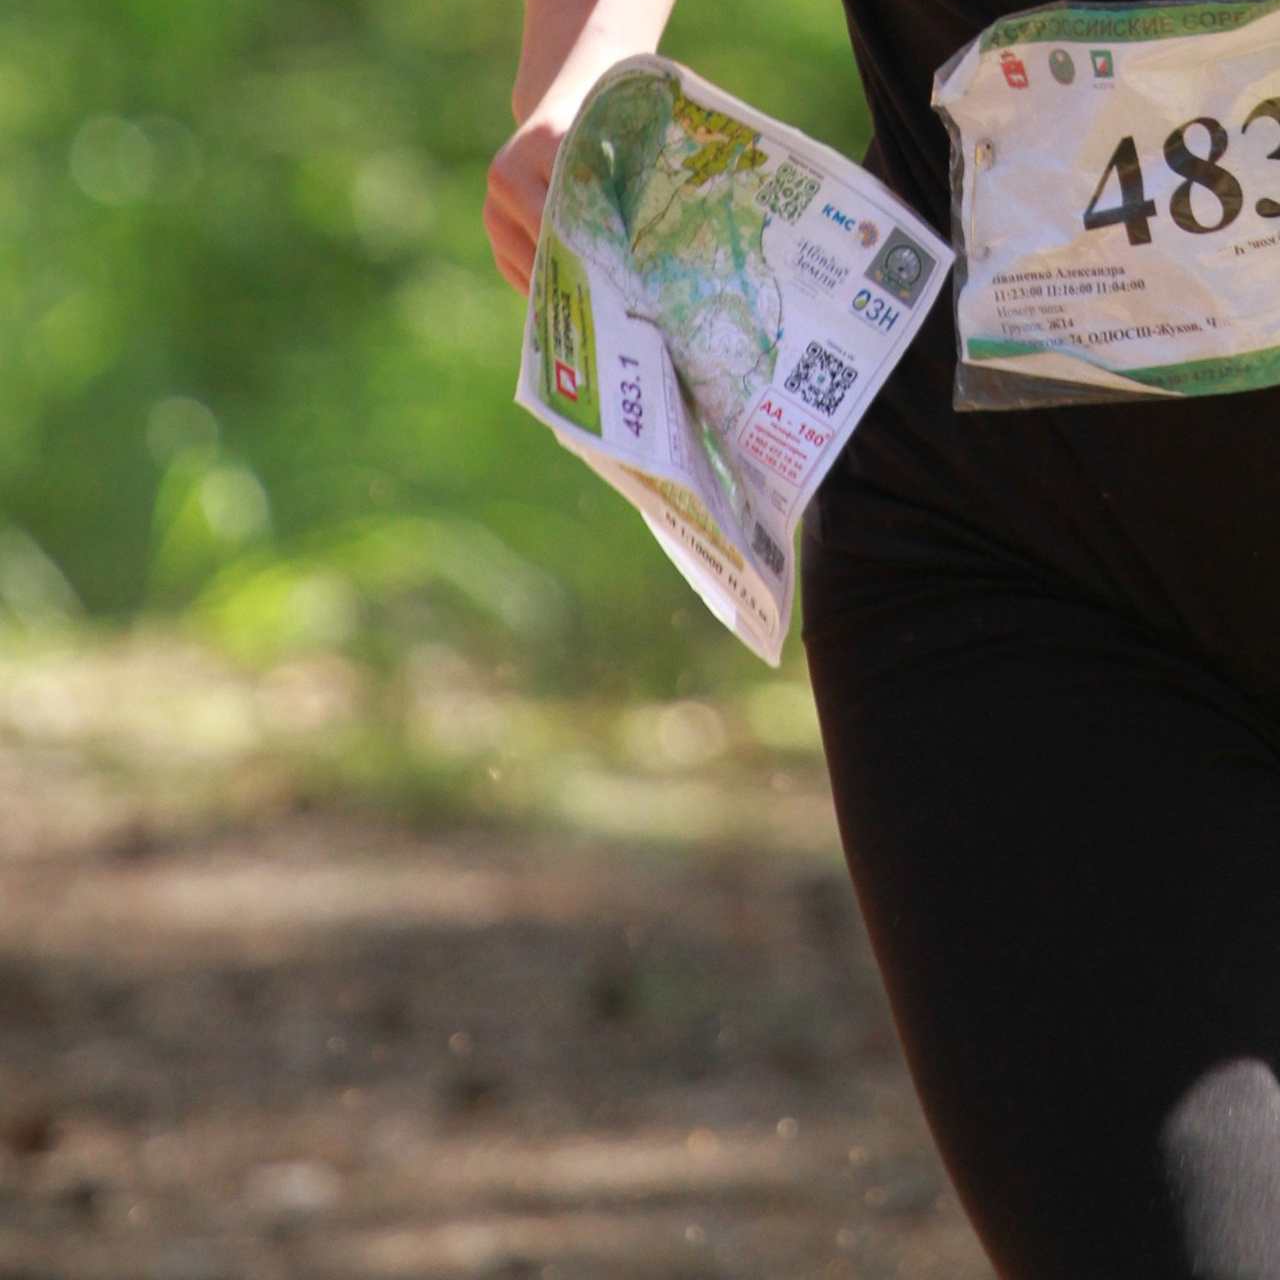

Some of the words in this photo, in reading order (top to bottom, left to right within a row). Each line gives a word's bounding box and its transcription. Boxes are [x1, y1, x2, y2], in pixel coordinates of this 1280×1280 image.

[1046, 283, 1093, 298] 11:16:00
[1096, 280, 1146, 294] 11:04:00
[618, 354, 644, 438] 483.1
